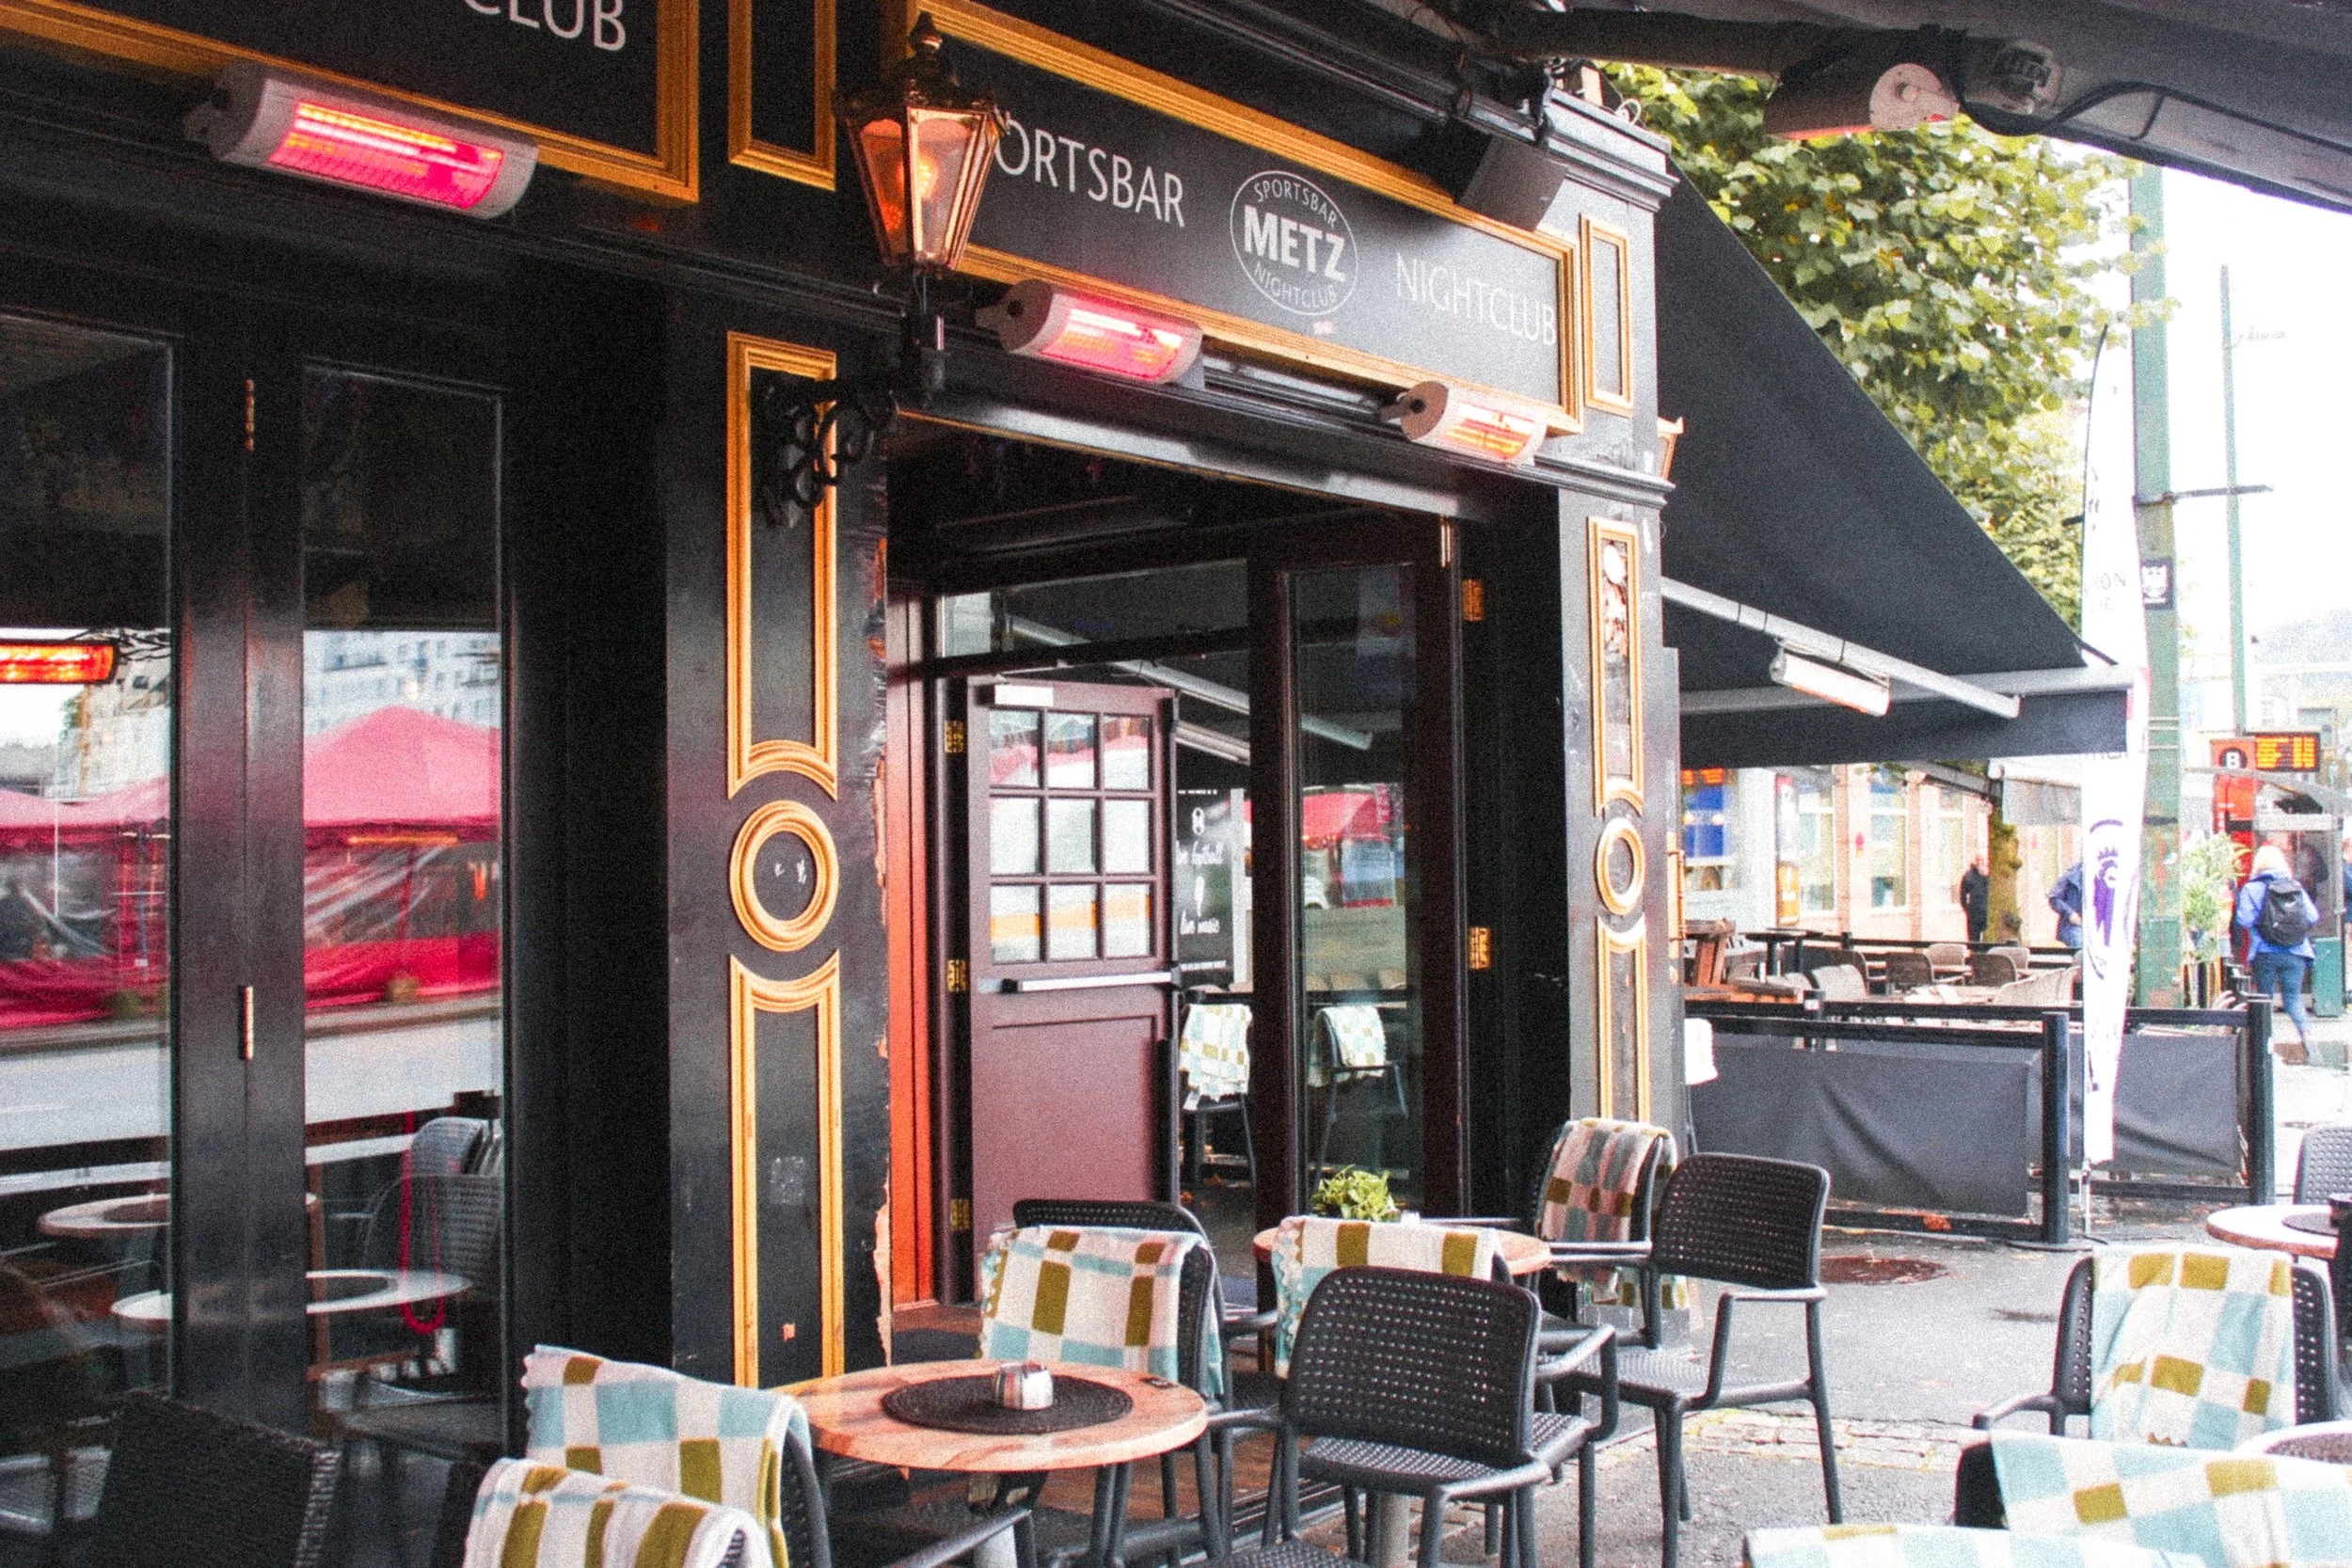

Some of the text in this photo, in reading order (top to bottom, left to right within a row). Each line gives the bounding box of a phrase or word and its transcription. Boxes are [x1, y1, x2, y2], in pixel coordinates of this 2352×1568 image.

[1254, 179, 1338, 229] SPORTSBAR
[1244, 204, 1346, 282] METZ
[1254, 261, 1338, 308] NIGHTCLUB
[1396, 252, 1556, 345] NIGHTCLUB
